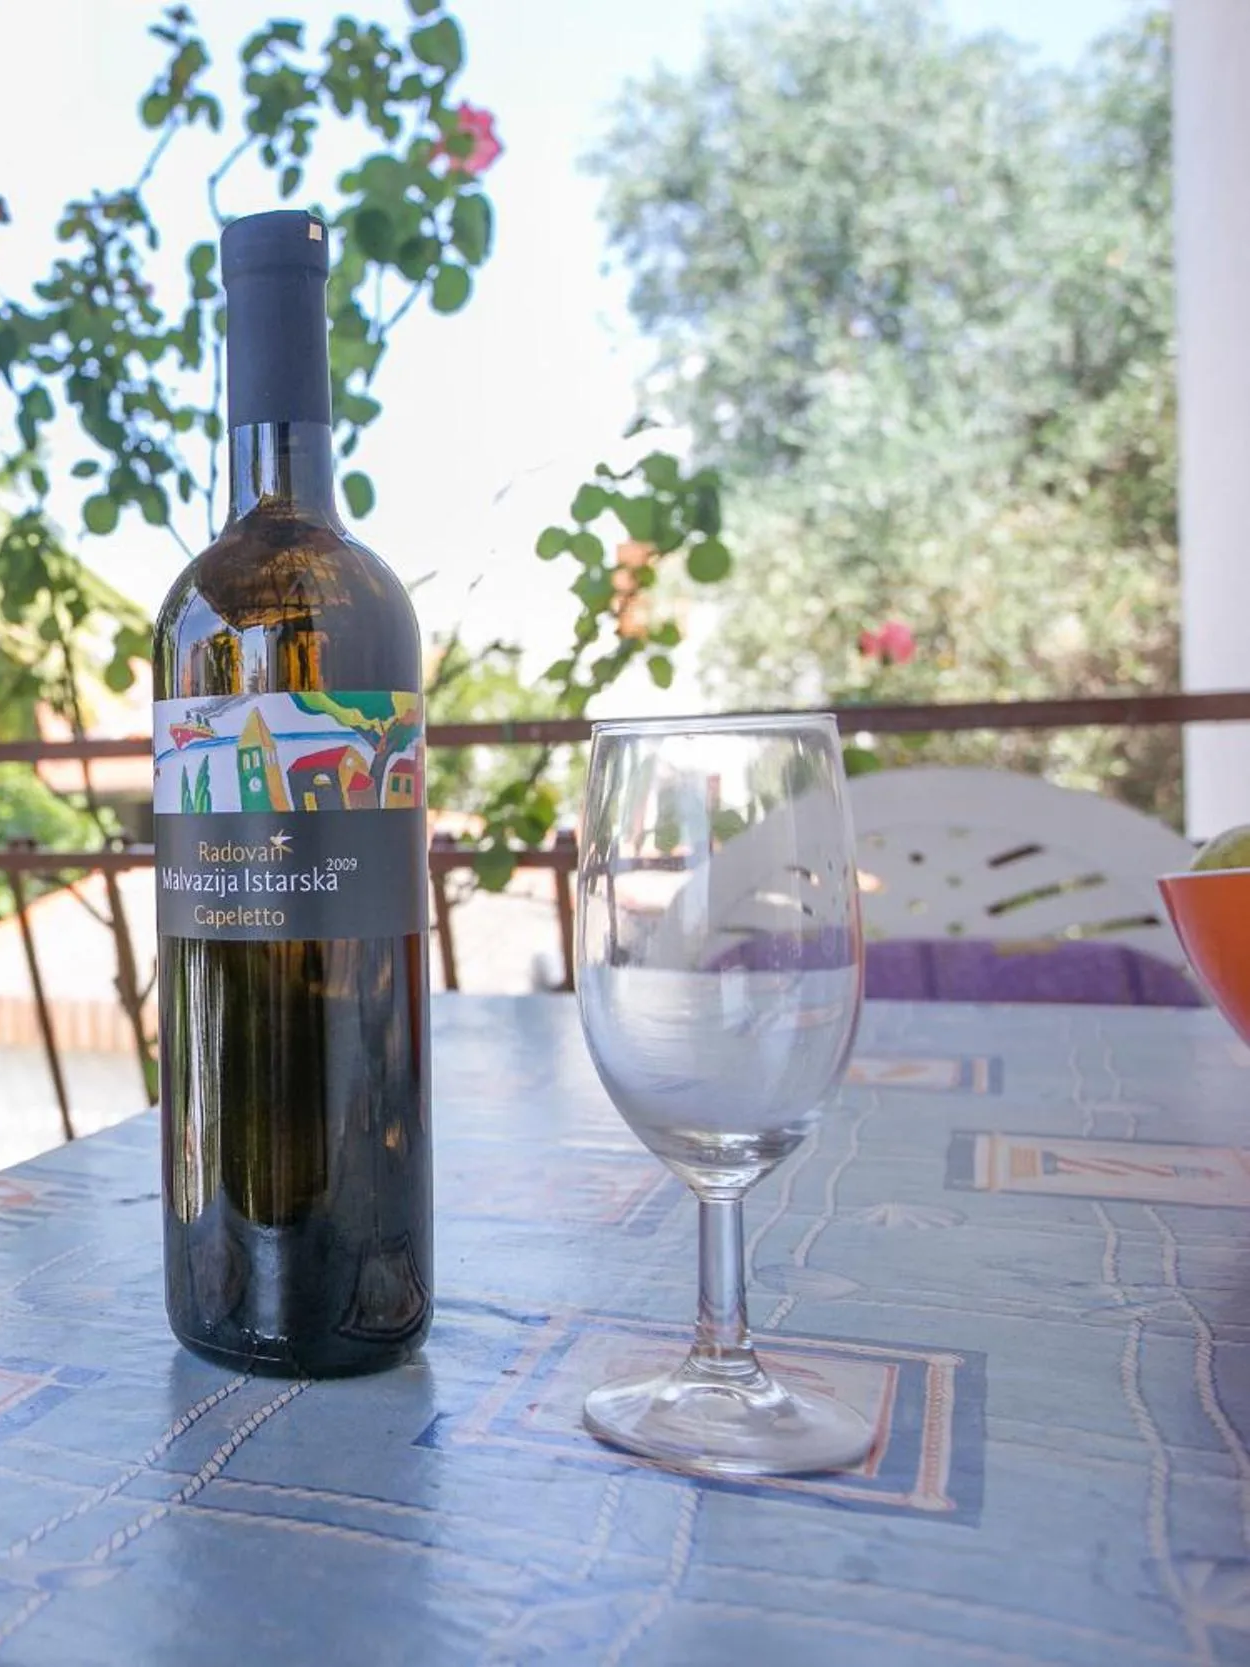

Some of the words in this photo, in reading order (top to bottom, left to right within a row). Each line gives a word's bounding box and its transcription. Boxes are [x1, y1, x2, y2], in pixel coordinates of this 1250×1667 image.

[197, 840, 283, 863] Radovan
[325, 857, 358, 872] 2009
[161, 866, 239, 898] Malvazija
[244, 866, 339, 892] Istarska
[193, 903, 285, 928] Capeletto
